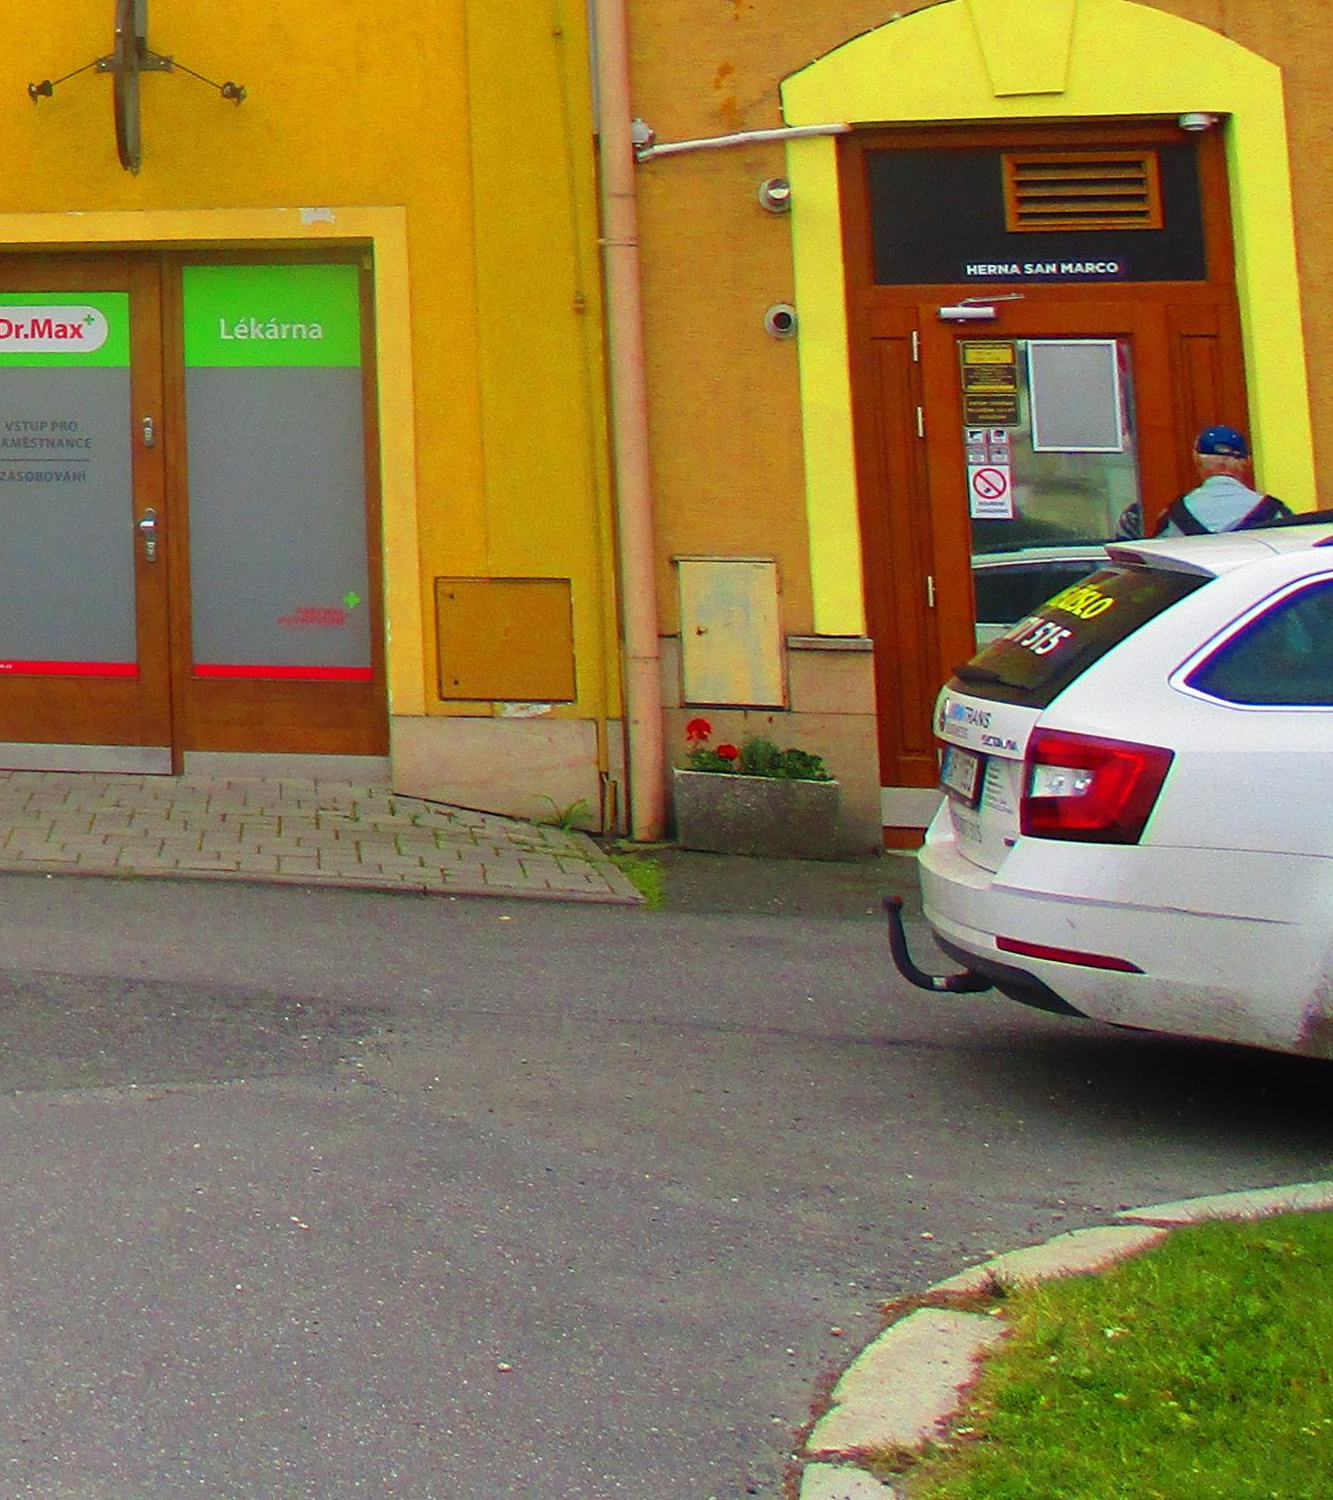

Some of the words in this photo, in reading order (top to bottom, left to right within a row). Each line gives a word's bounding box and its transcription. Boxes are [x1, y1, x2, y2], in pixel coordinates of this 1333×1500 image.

[966, 263, 1022, 275] HERNA
[1023, 262, 1057, 275] SAN
[1060, 261, 1119, 274] MARCO
[219, 317, 323, 340] Lékárna
[4, 420, 48, 432] VSTUP
[51, 420, 78, 432] PRO
[1020, 621, 1073, 655] 515
